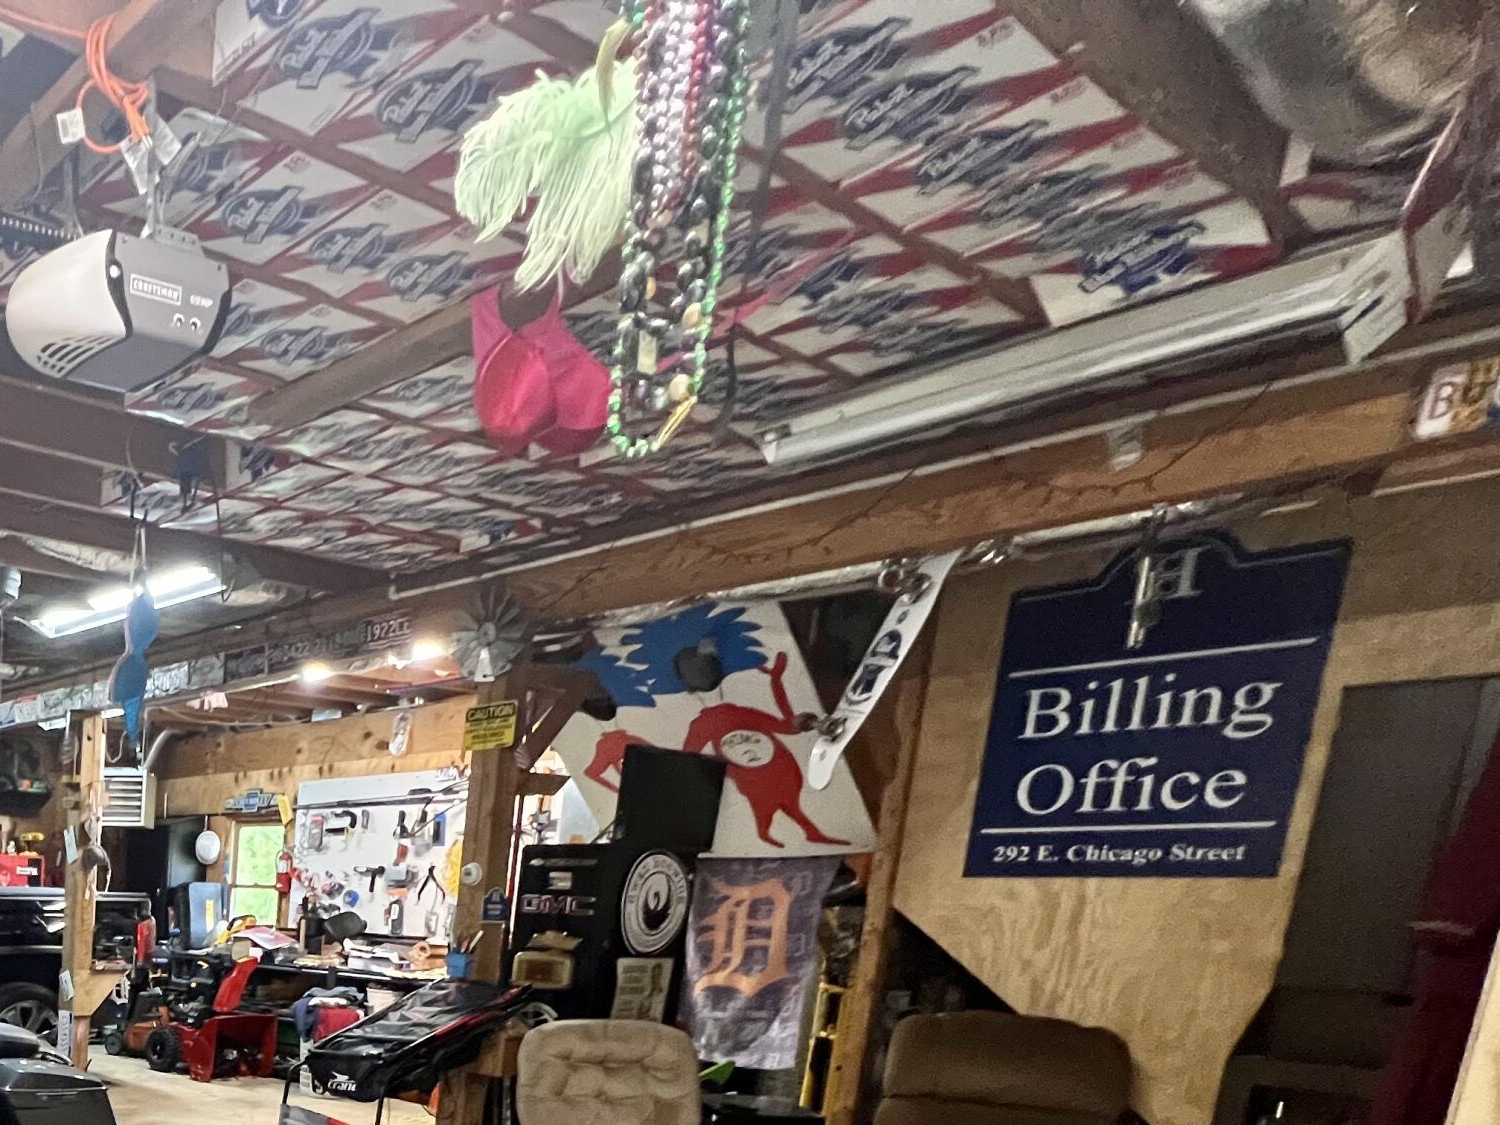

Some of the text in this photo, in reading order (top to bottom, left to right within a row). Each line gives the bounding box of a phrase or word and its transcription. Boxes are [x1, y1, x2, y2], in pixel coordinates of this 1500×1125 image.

[1016, 672, 1284, 740] Billing
[1015, 755, 1248, 816] Office
[992, 842, 1247, 866] 292 E. Chicago Street
[520, 893, 597, 916] GMC
